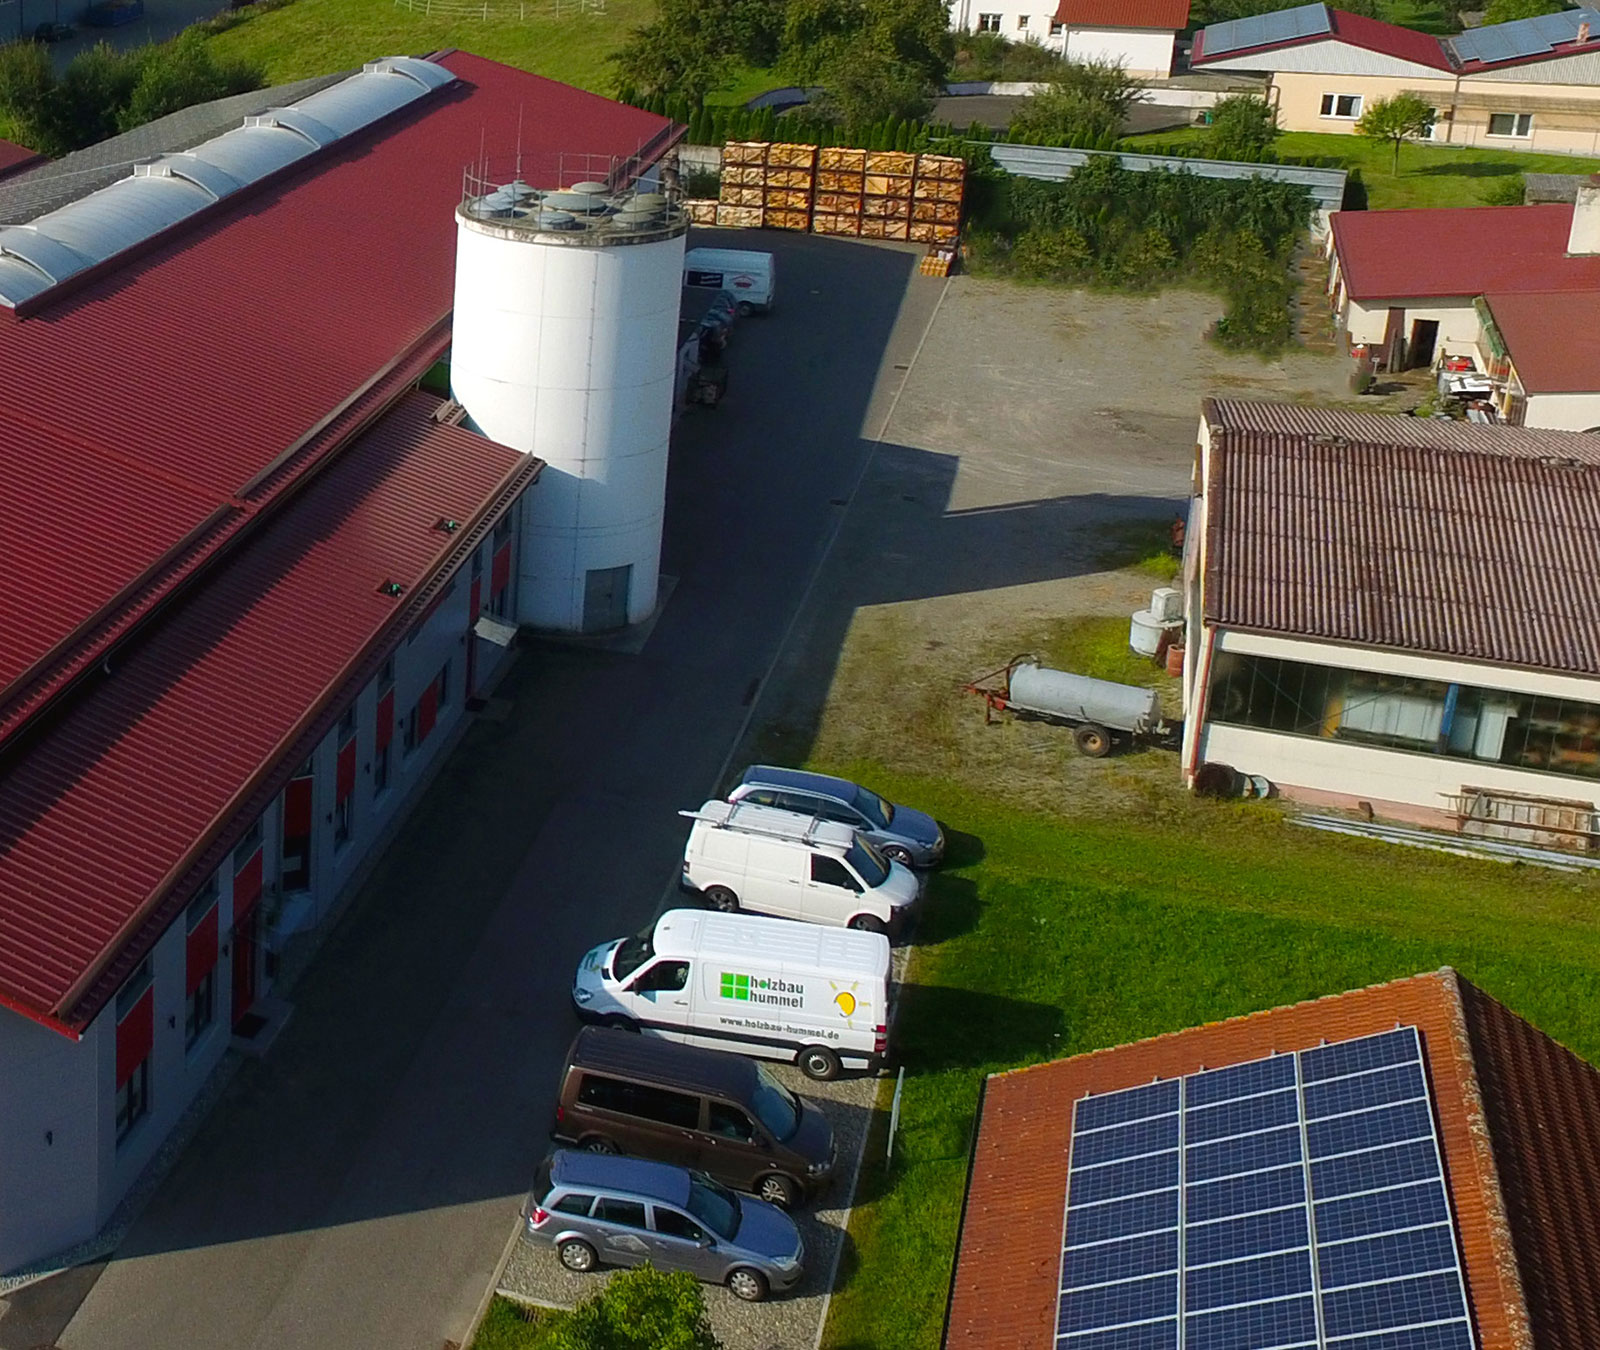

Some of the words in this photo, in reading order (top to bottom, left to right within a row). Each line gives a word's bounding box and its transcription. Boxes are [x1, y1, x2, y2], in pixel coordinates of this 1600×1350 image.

[750, 975, 804, 994] holzbau
[750, 989, 804, 1008] hummel
[719, 1016, 840, 1040] www.holzbau-hummel.de
